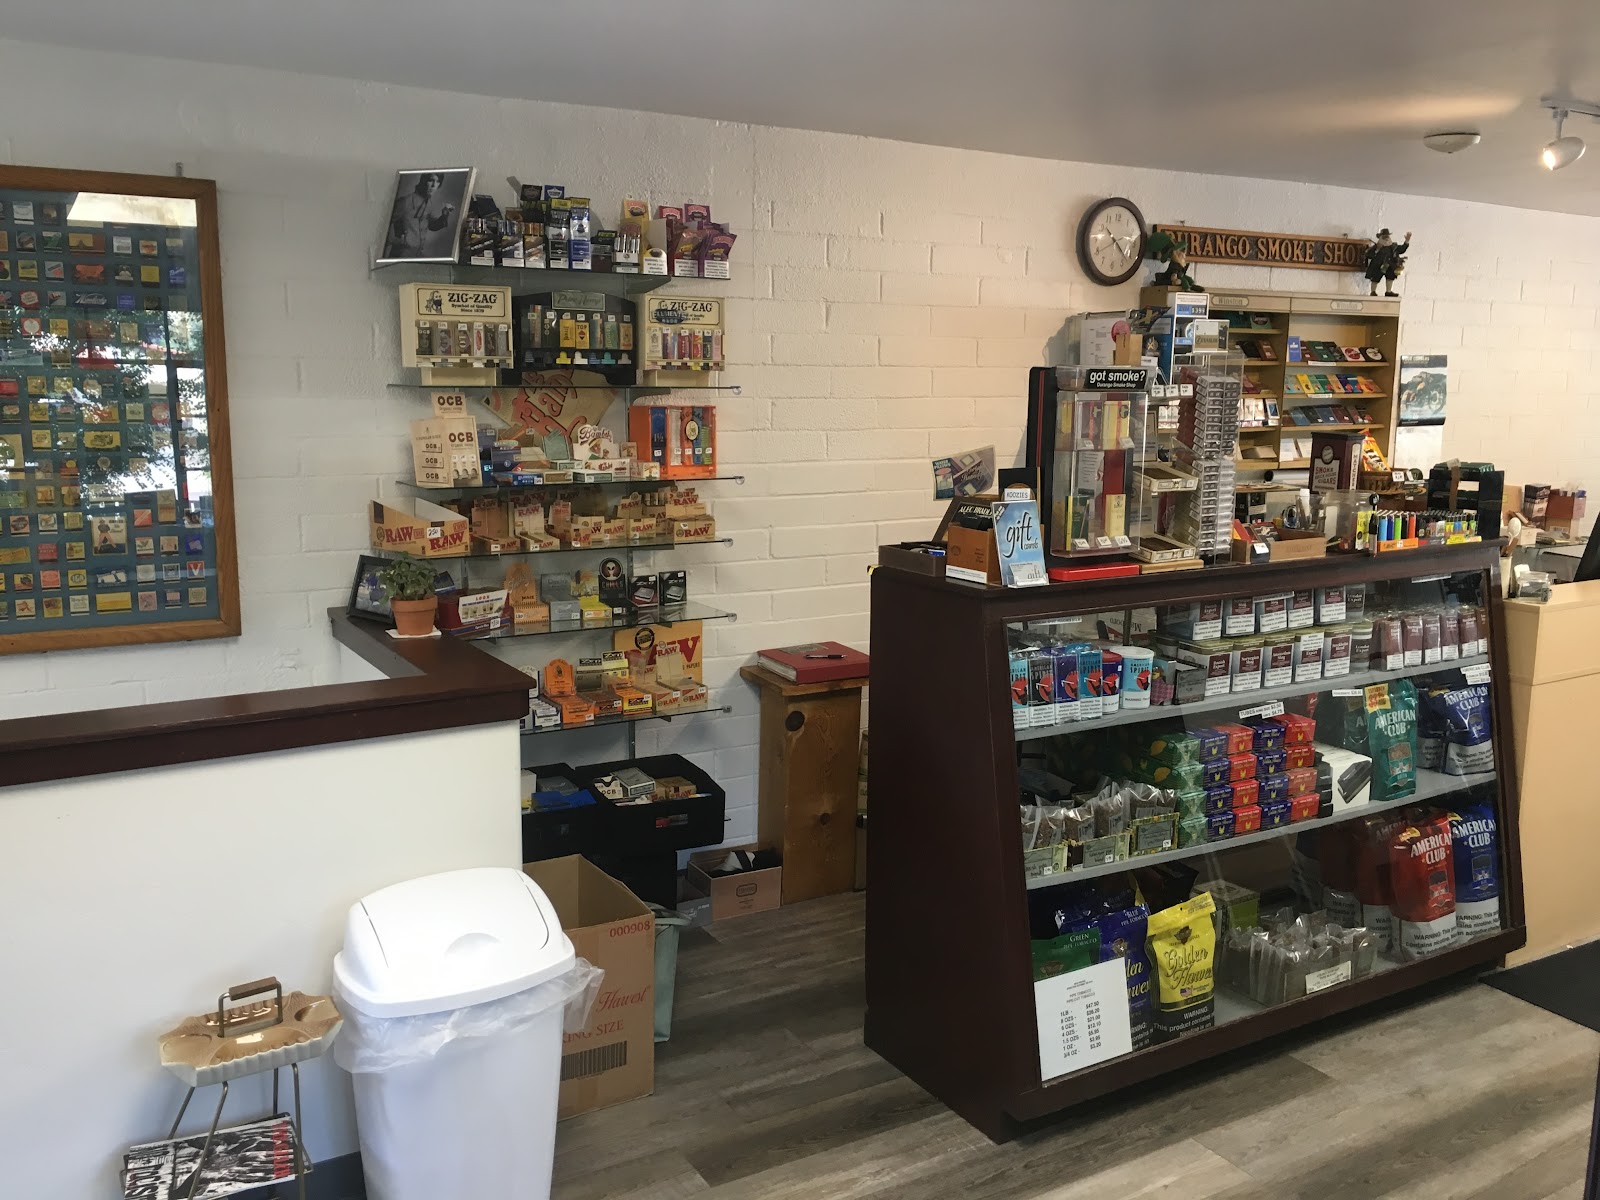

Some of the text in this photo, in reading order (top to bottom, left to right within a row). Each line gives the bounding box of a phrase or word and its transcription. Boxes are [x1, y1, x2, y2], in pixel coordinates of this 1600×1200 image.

[1115, 213, 1122, 222] 12
[1257, 238, 1315, 262] SMOKE
[447, 292, 497, 304] ZIG-ZAG
[1218, 297, 1243, 305] Winston
[670, 301, 713, 312] ZIG-ZAG
[1089, 370, 1146, 383] got smoke?
[437, 395, 463, 406] OCB
[448, 432, 474, 443] OCB
[425, 472, 440, 480] OCB
[621, 500, 640, 510] RAW
[673, 497, 698, 506] RAW
[517, 505, 540, 517] RAW
[635, 523, 654, 533] RAW
[684, 526, 711, 538] RAW
[384, 526, 413, 543] RAW
[429, 531, 465, 550] RAW
[1002, 511, 1033, 558] gift
[657, 646, 678, 657] RAW
[662, 697, 679, 706] RAW
[688, 693, 705, 702] RAW
[1445, 686, 1489, 706] AMERICAN
[1459, 697, 1480, 711] CLUB
[1240, 709, 1256, 717] TUBES
[1375, 709, 1416, 730] AMERICAN
[1387, 722, 1406, 737] CLUB
[1468, 832, 1491, 848] CLUB
[1425, 847, 1446, 865] CLUB
[609, 921, 651, 938] 000908
[1069, 933, 1090, 943] GREEN
[1164, 945, 1208, 978] Golden
[596, 1020, 624, 1036] SIZE
[1153, 1022, 1168, 1031] This
[1169, 1021, 1191, 1033] product
